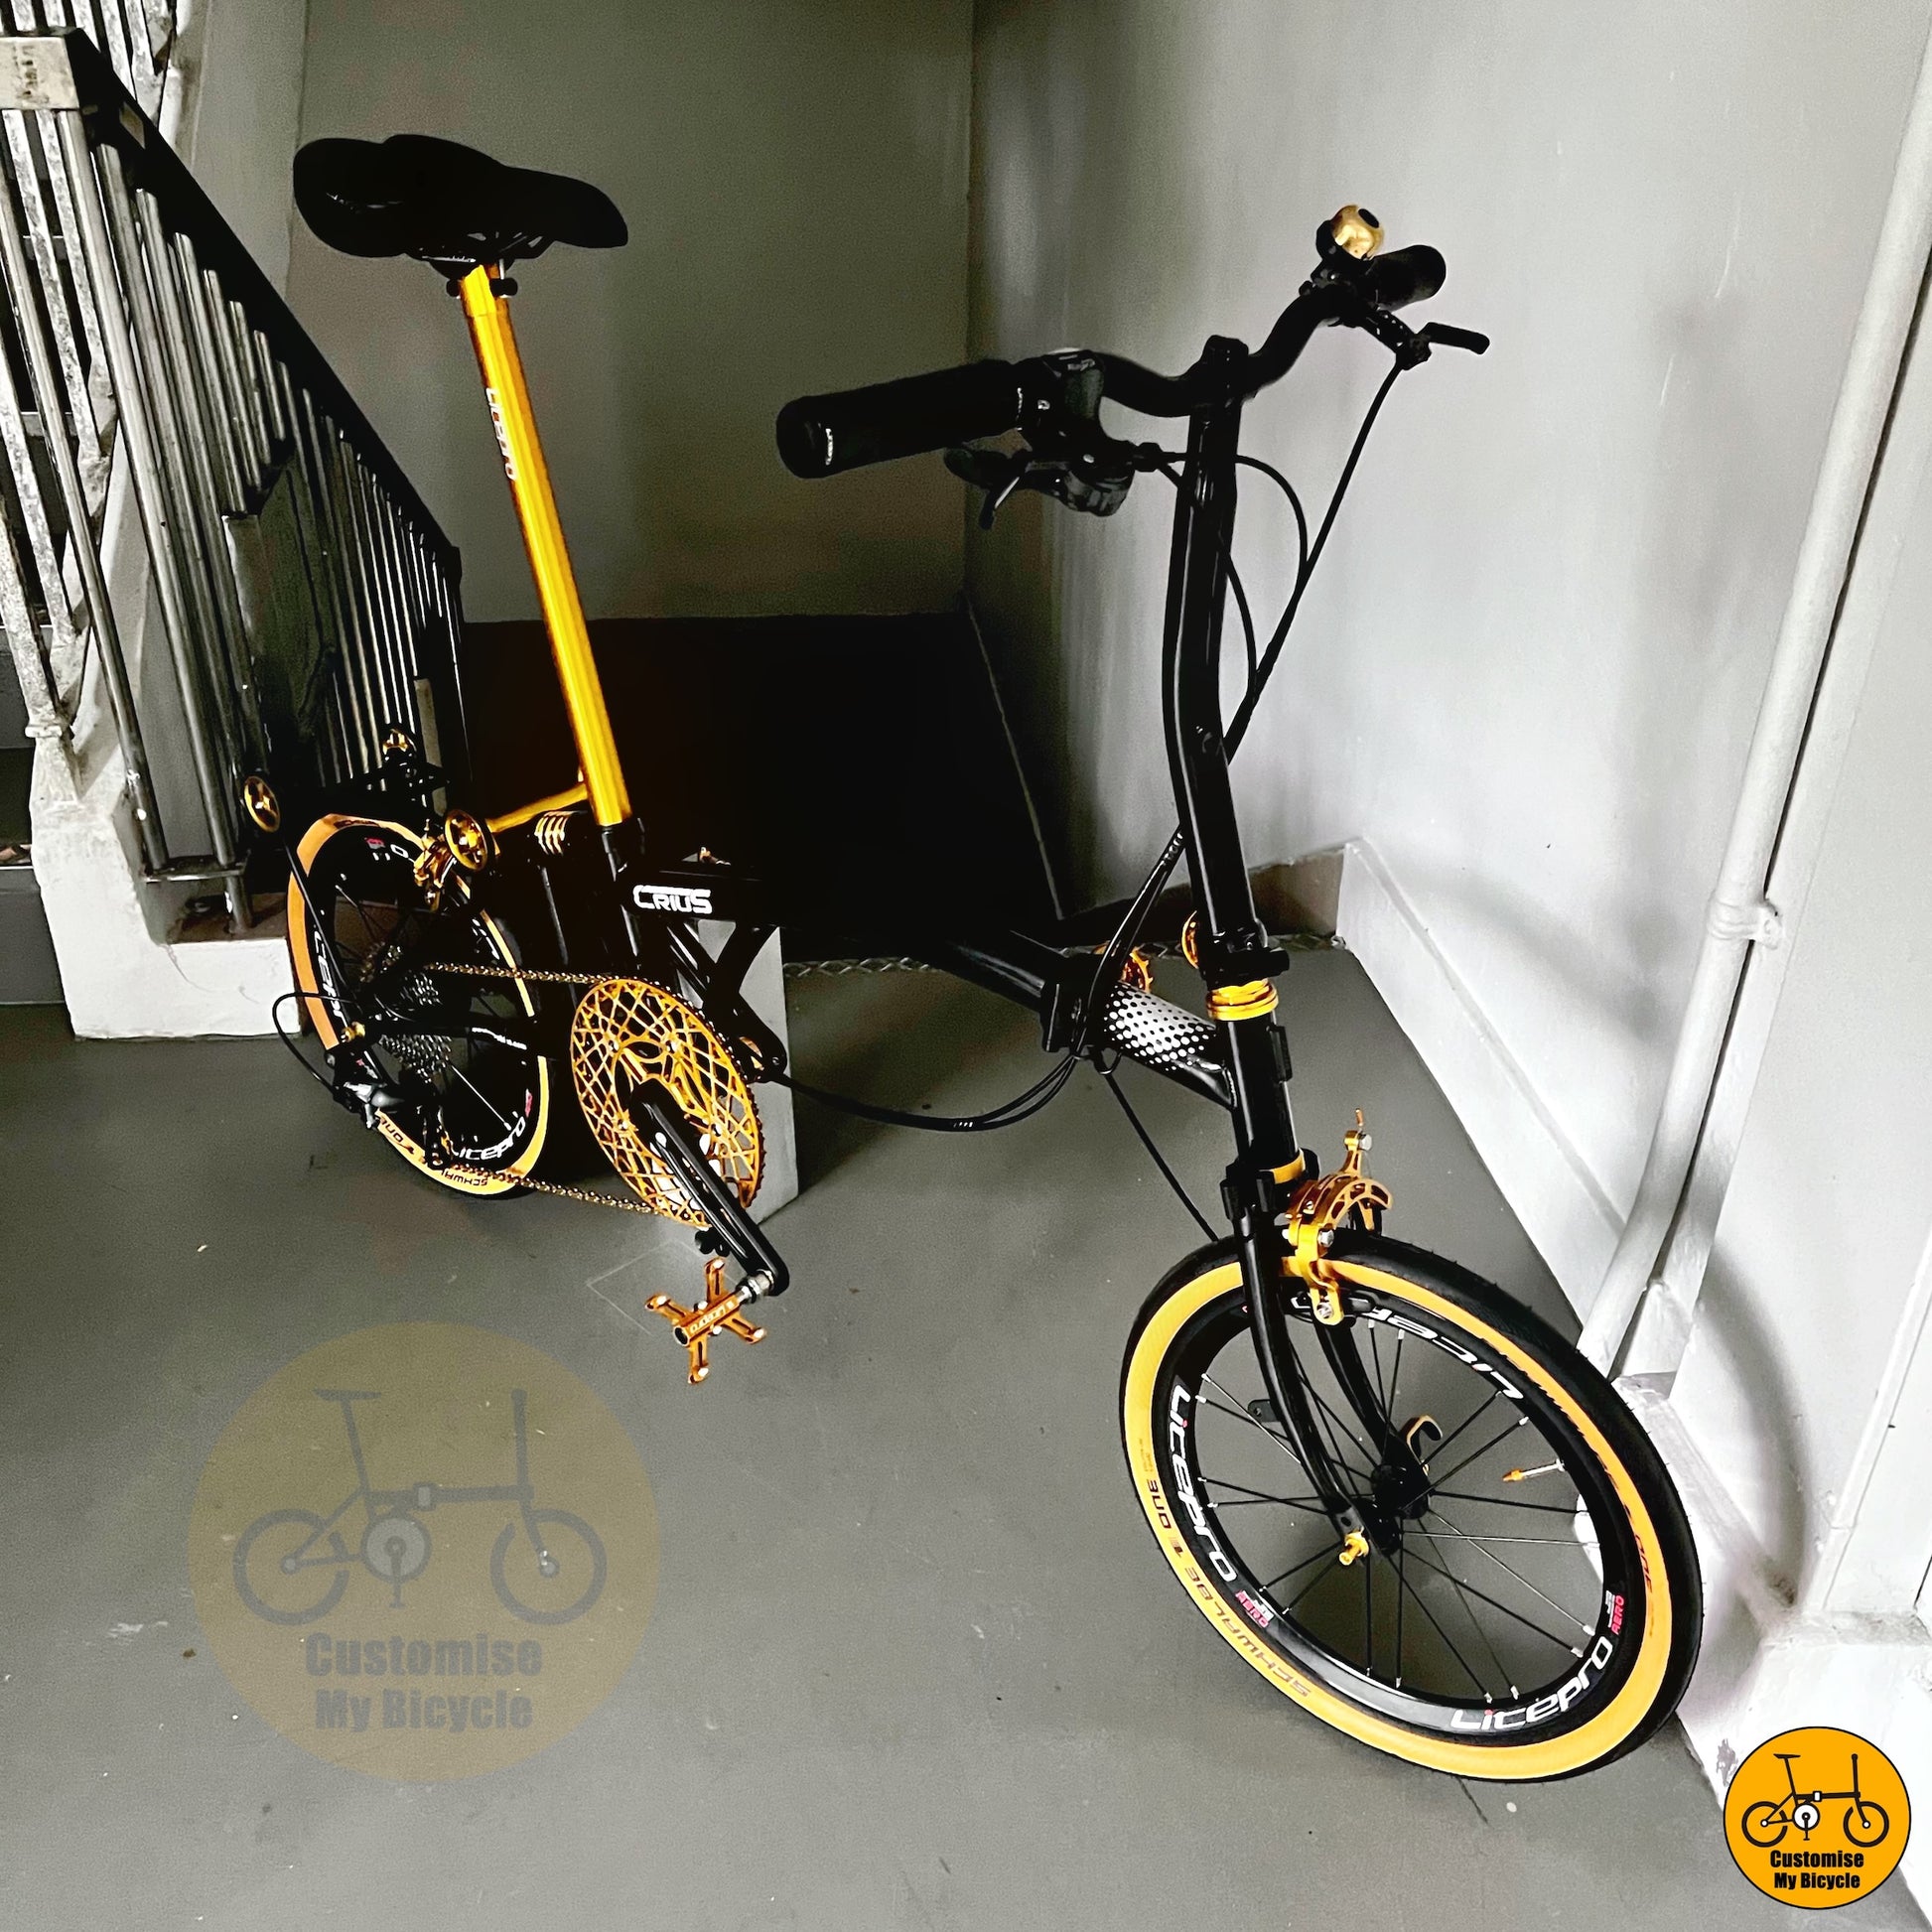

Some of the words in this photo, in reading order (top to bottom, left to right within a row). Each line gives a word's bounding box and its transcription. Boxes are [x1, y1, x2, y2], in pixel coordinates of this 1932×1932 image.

[632, 885, 713, 914] CRIUS
[1146, 1478, 1173, 1529] ONE
[1184, 1567, 1311, 1698] SCHWALBE
[1610, 1594, 1625, 1635] AERO
